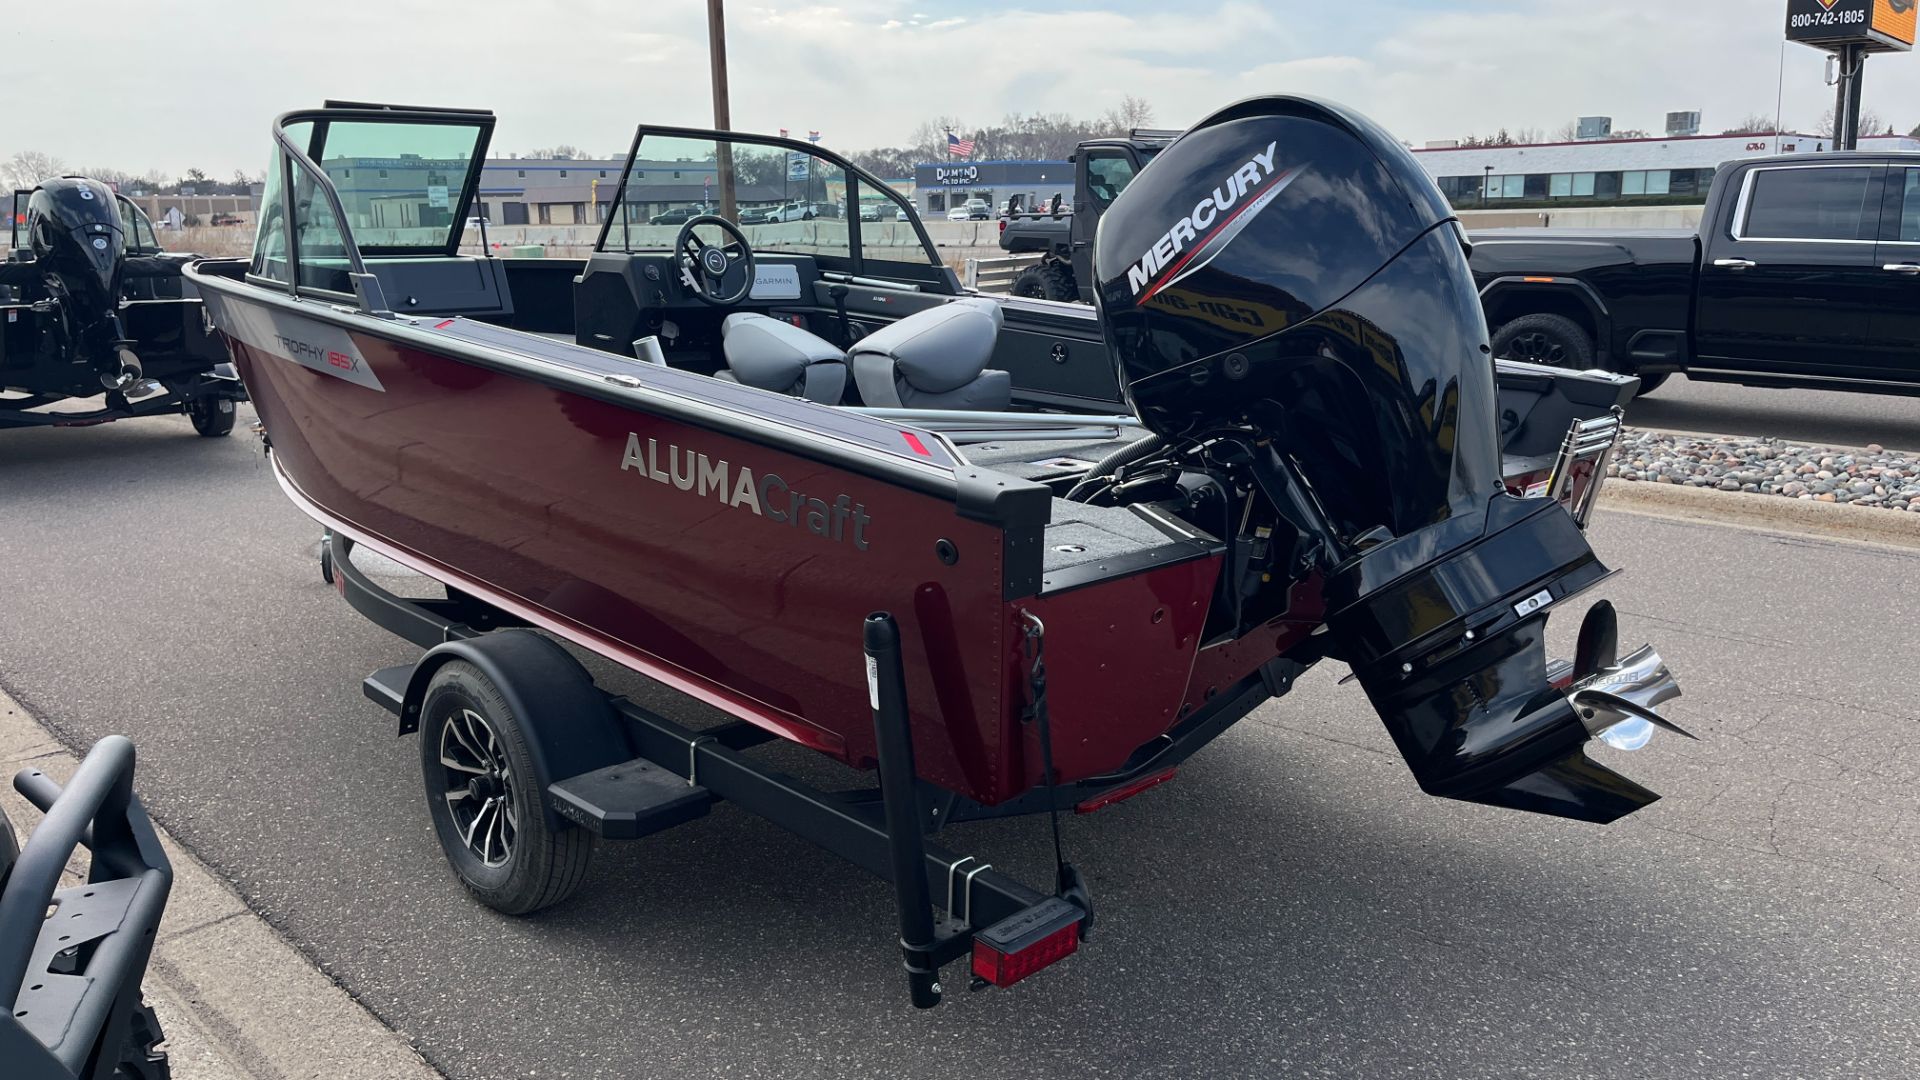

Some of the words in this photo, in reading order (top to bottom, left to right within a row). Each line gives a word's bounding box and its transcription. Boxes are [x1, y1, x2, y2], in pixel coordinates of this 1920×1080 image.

[1791, 9, 1865, 28] 800-742-1805
[1127, 140, 1277, 296] MERCURY
[755, 278, 793, 286] GARMIN
[274, 334, 325, 361] TROPHY
[621, 431, 871, 551] ALUMACraft
